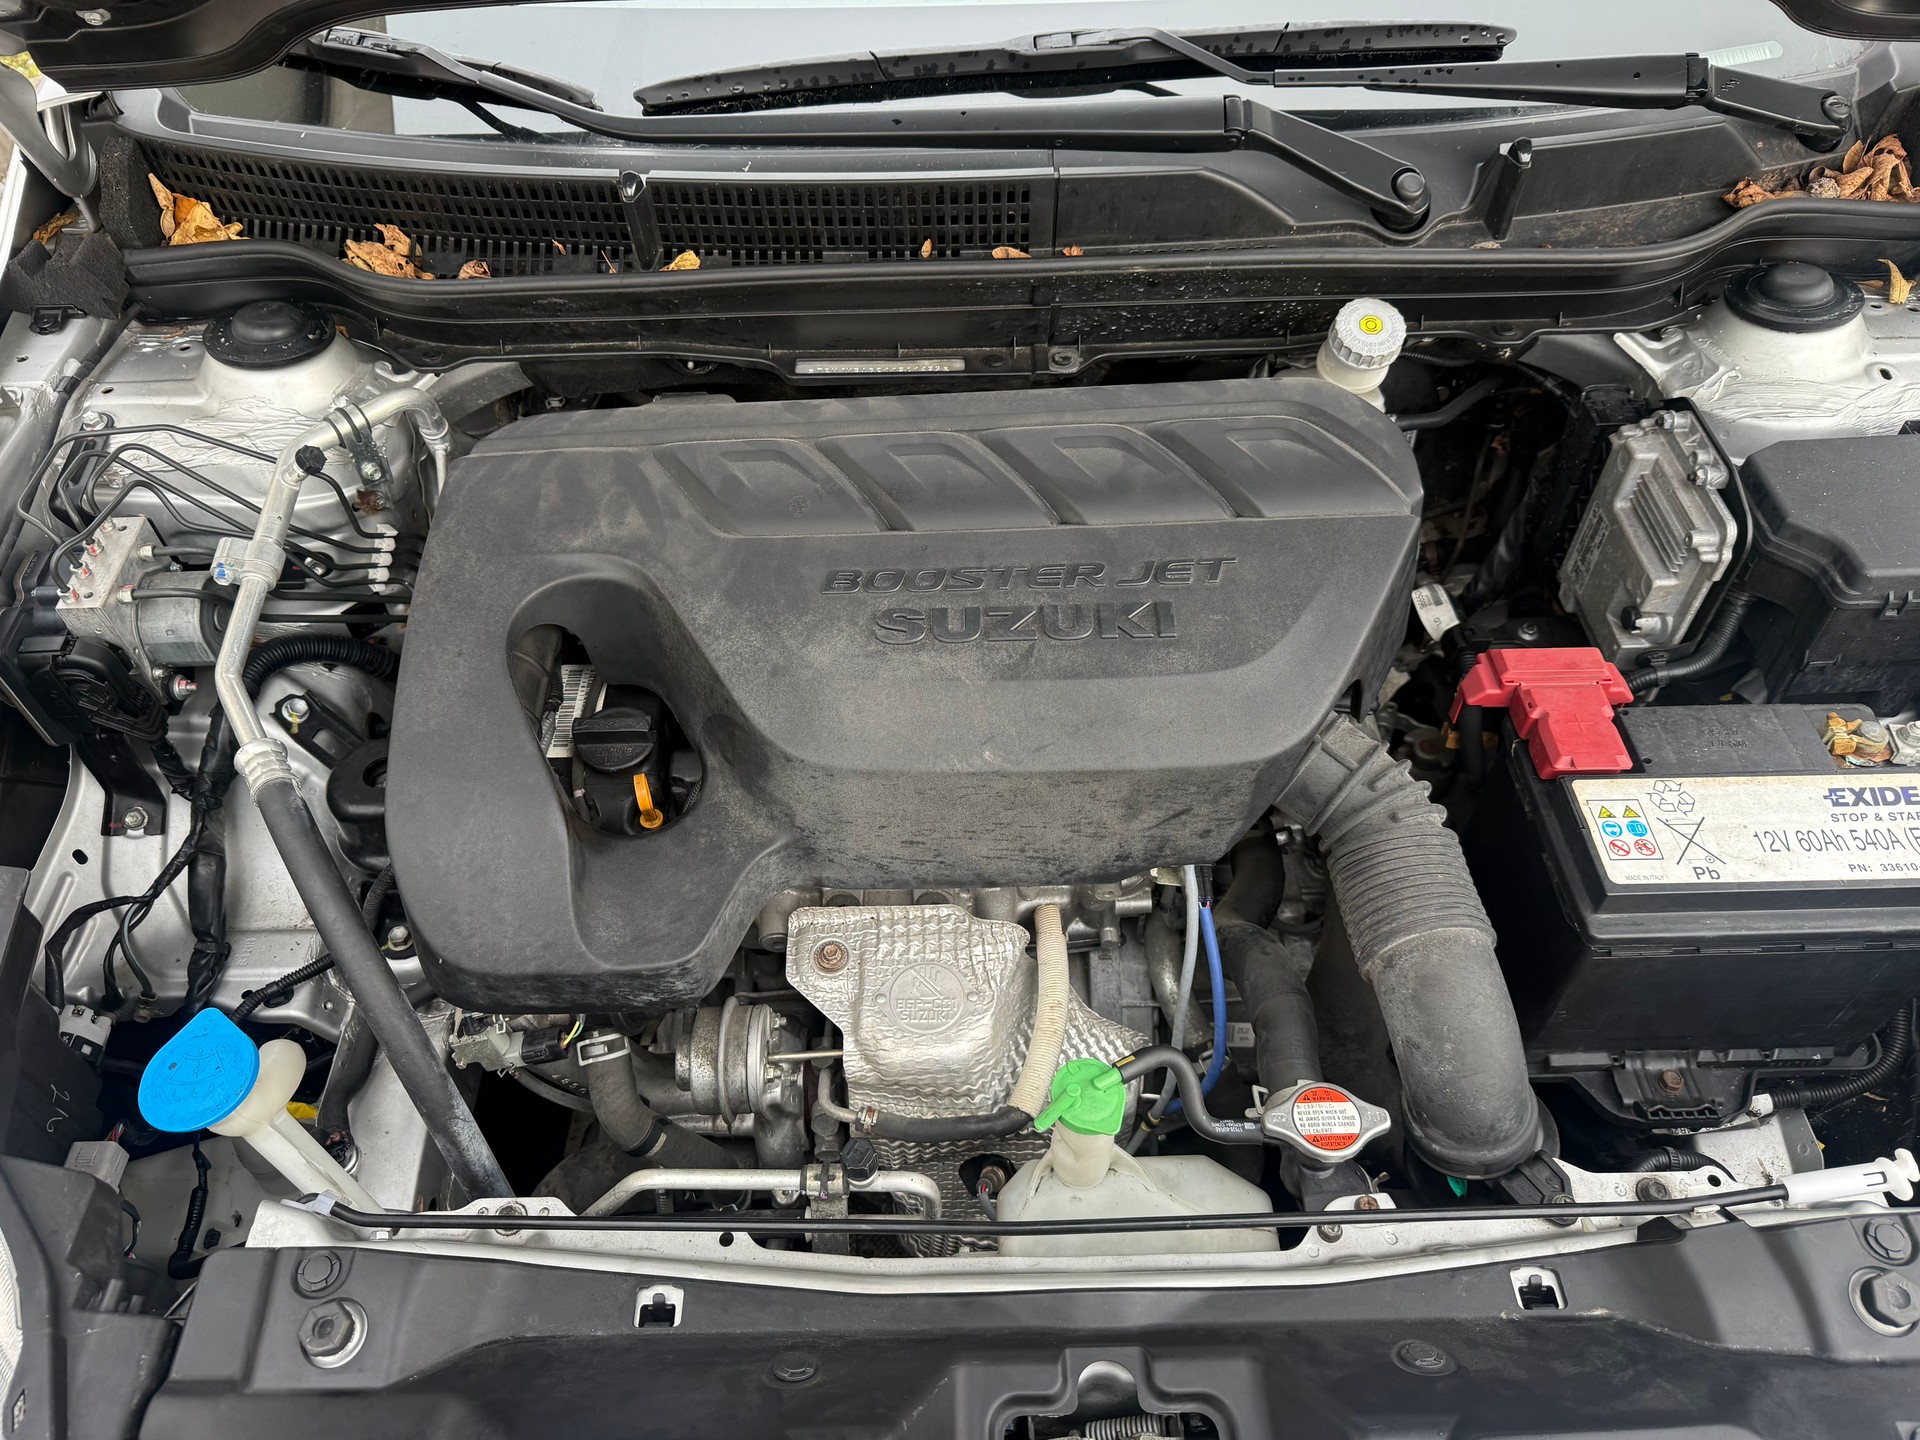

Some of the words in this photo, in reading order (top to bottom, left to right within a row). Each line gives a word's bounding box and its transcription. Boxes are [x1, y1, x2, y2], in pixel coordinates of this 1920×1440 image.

[821, 561, 1107, 594] BOOSTER
[1116, 557, 1238, 586] JET
[874, 601, 1177, 645] SUZUKI
[1823, 786, 1920, 807] EXIDE
[1831, 813, 1868, 822] STOP
[1874, 812, 1884, 821] &
[1753, 830, 1791, 852] 12V
[1795, 829, 1850, 852] 60Ah
[1849, 827, 1906, 851] 540A
[1692, 866, 1721, 880] Pb
[1848, 863, 1872, 873] PN:
